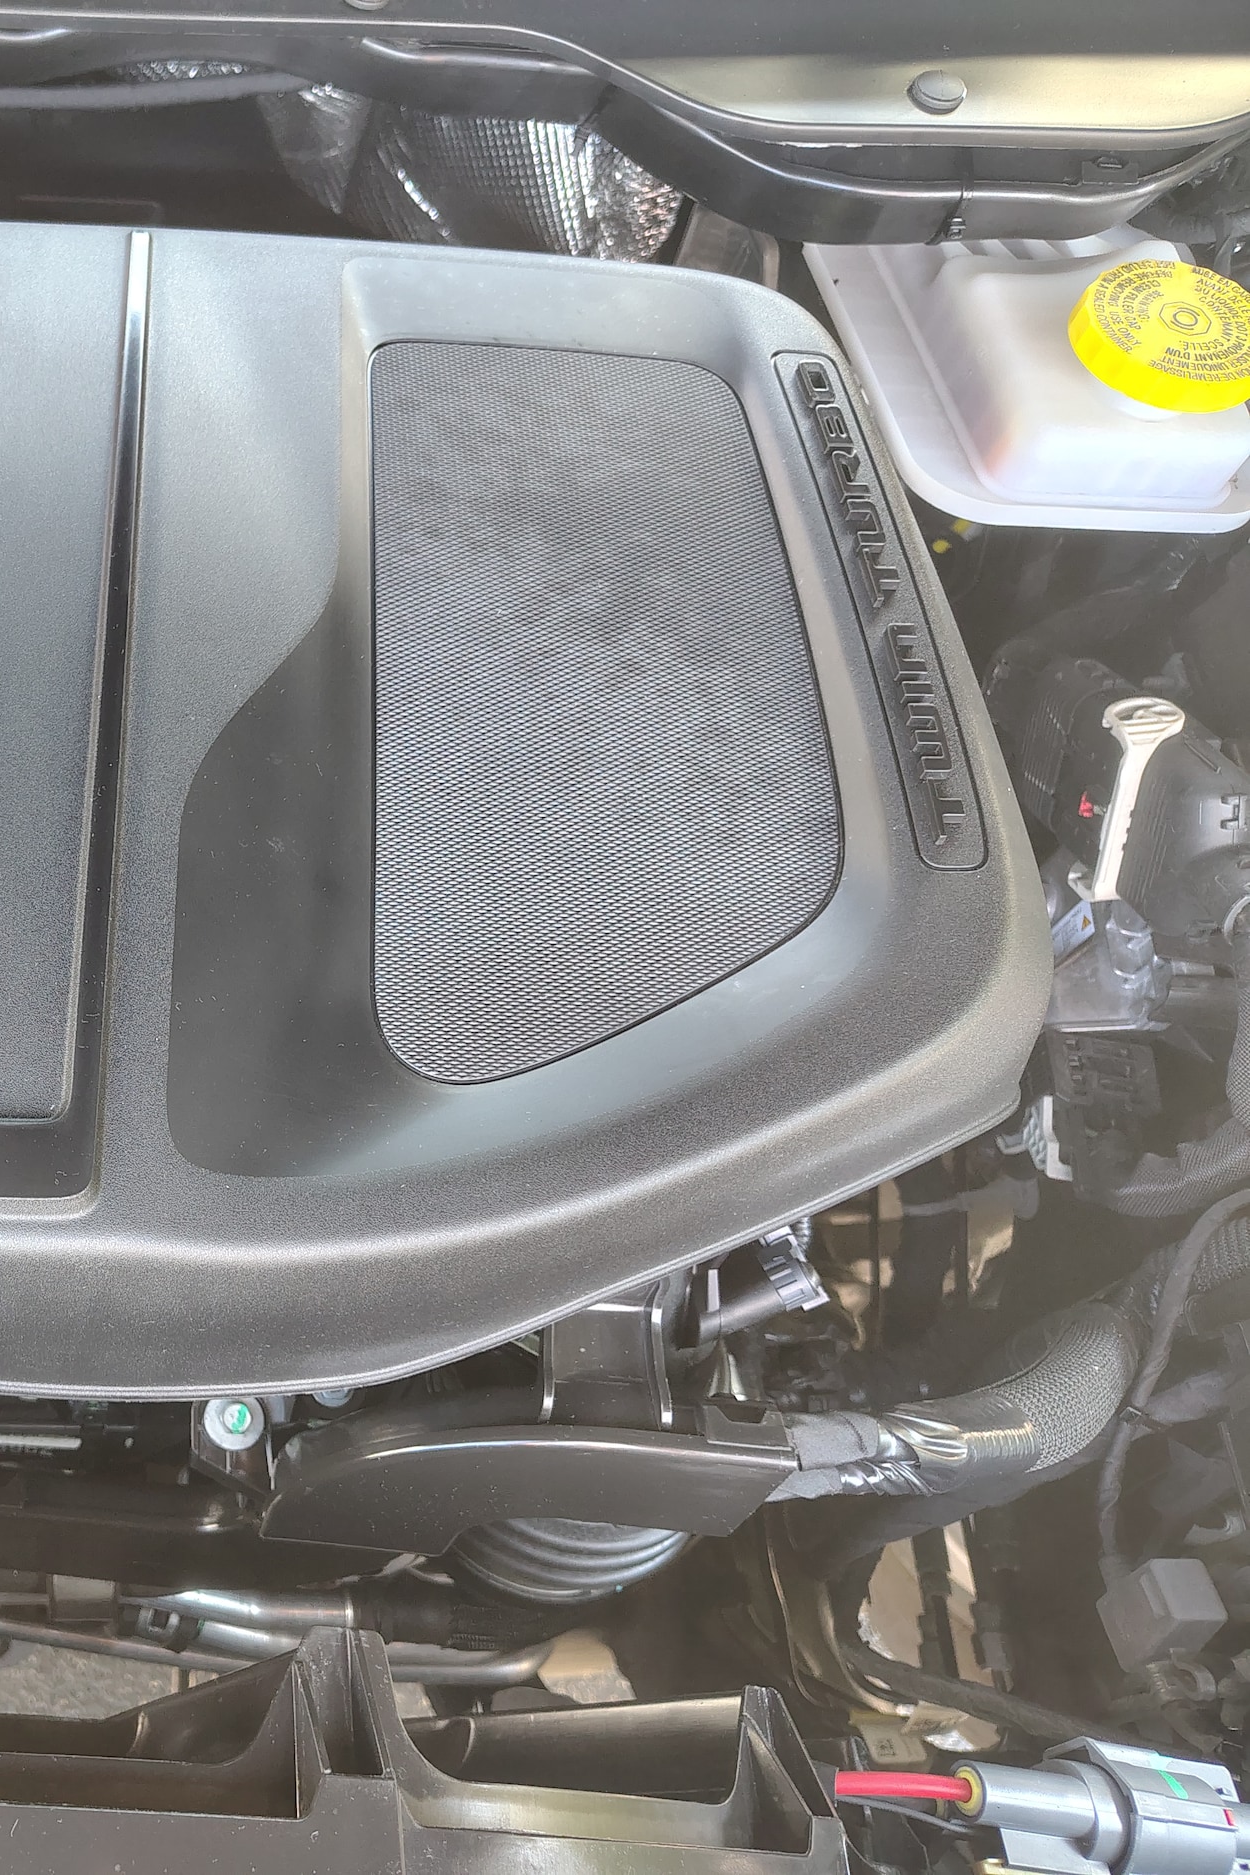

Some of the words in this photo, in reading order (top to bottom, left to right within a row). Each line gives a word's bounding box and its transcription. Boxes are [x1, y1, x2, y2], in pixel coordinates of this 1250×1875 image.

[1192, 266, 1217, 281] MISE
[1217, 277, 1232, 288] EN
[1093, 289, 1106, 313] SEALED
[1195, 285, 1210, 295] DU
[1196, 278, 1229, 295] AVANT
[1228, 295, 1243, 305] DE
[1238, 305, 1250, 314] LE
[1122, 291, 1138, 314] FILLER
[1211, 293, 1243, 320] LIQUIDE
[1109, 311, 1124, 325] USE
[1118, 327, 1142, 345] ONLY
[1124, 316, 1141, 330] CAP
[1199, 296, 1233, 342] CONTENANT
[1235, 321, 1248, 336] DOT
[1195, 340, 1245, 361] PROVENANT
[1148, 360, 1220, 381] REMPLISSAGE
[1161, 355, 1229, 371] UNIQUEMENT
[1220, 372, 1237, 380] DE
[796, 360, 900, 607] TURBO
[883, 623, 965, 844] TWIN
